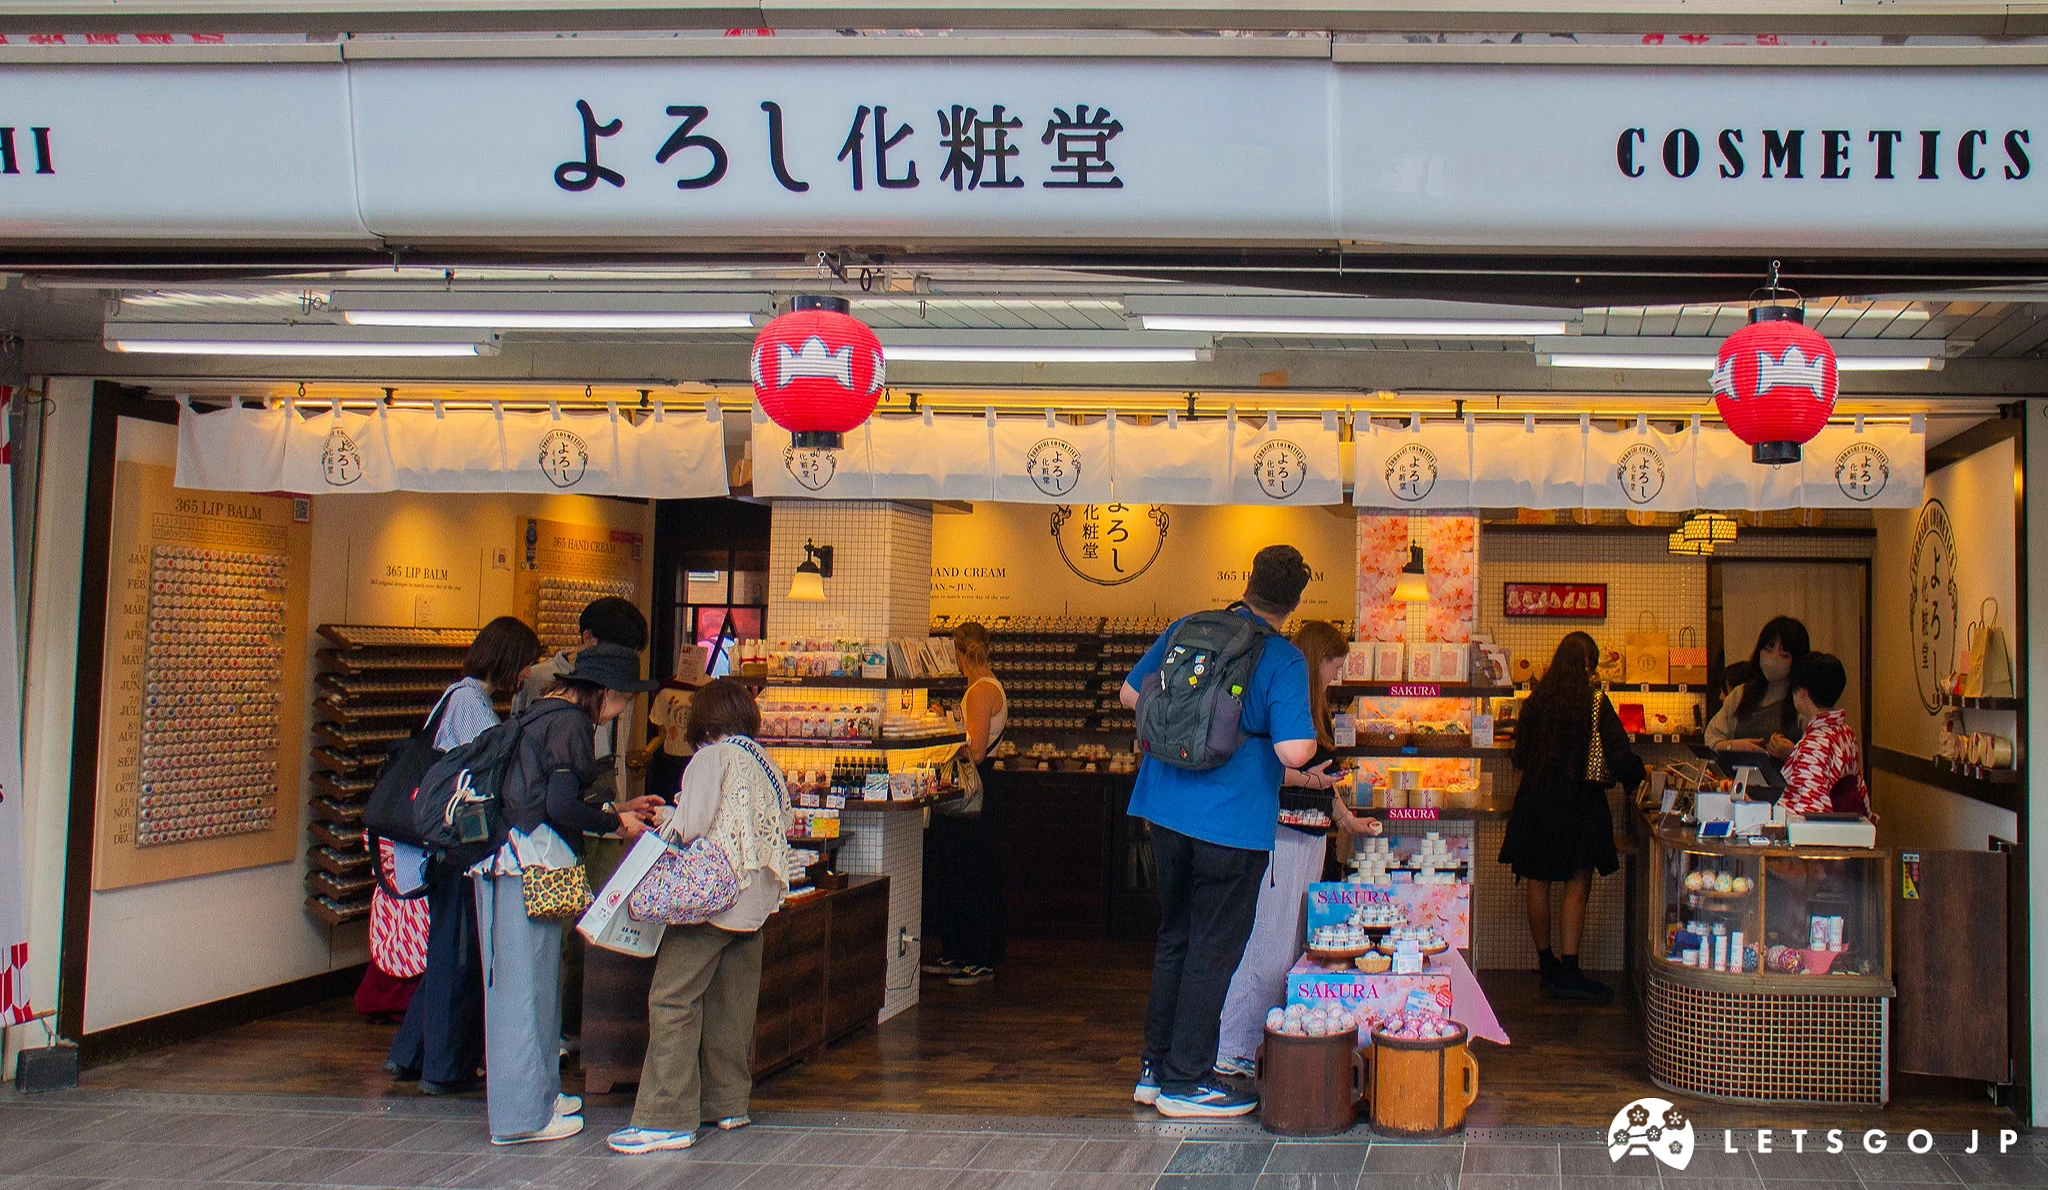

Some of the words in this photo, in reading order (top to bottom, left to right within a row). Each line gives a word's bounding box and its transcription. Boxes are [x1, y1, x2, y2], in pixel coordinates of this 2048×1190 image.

[554, 100, 1124, 192] よろし化粧堂
[1616, 127, 2032, 181] COSMETICS
[338, 440, 349, 481] よろし
[558, 442, 570, 482] よろし
[1052, 451, 1063, 491] よろし
[1278, 452, 1289, 493] よろし
[1410, 456, 1420, 496] よろし
[1860, 455, 1872, 496] よろし
[1639, 457, 1650, 498] よろし
[176, 498, 198, 514] 365
[202, 501, 224, 516] LIP
[227, 505, 262, 520] BALM
[553, 537, 566, 548] 365
[568, 538, 589, 551] HAND
[591, 541, 616, 554] CREAM
[386, 565, 402, 577] 365
[405, 567, 421, 579] LIP
[424, 568, 448, 581] BALM
[964, 567, 1006, 578] CREAM
[1217, 571, 1237, 581] 365
[1390, 686, 1437, 696] SAKURA
[1389, 809, 1436, 819] SAKURA
[1317, 890, 1391, 905] SAKURA
[1298, 984, 1380, 999] SAKURA
